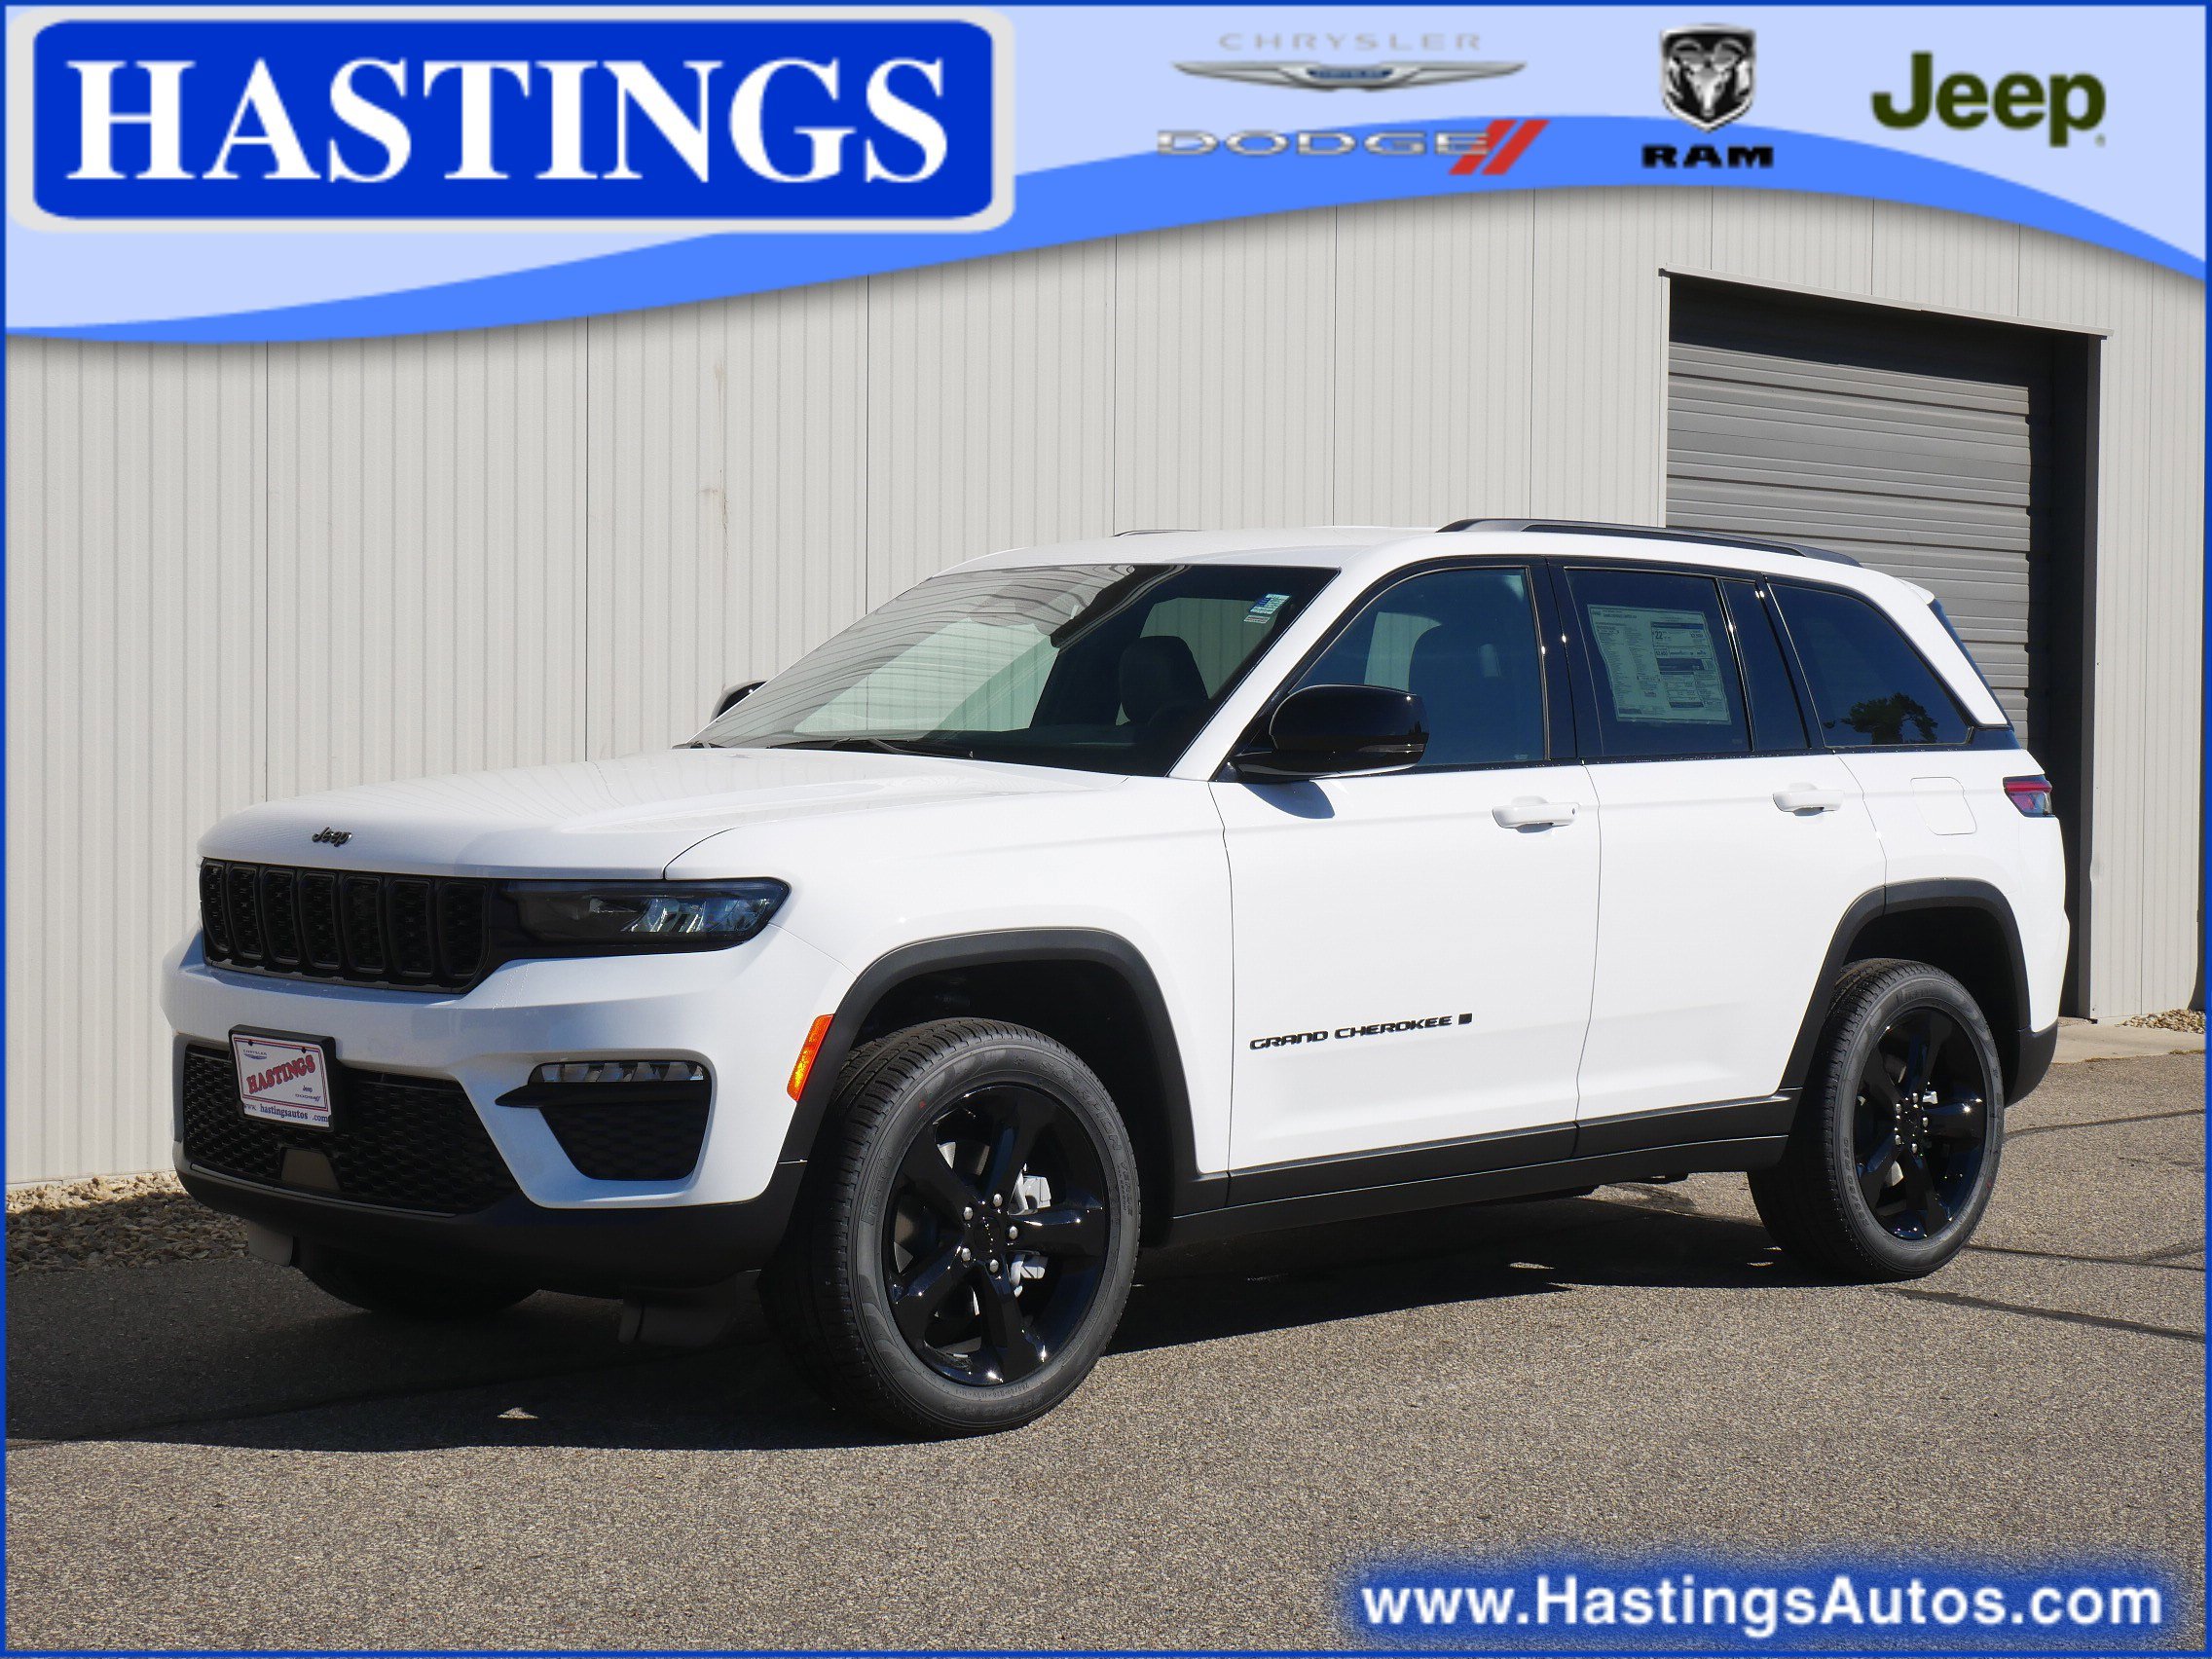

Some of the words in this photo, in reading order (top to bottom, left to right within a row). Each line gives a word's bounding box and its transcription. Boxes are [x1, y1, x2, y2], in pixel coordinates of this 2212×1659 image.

[312, 827, 351, 848] Jeep
[1249, 1030, 1329, 1051] GRAND
[1334, 1015, 1453, 1040] CHEROKEE
[246, 1054, 315, 1094] HASTINGS
[260, 1103, 309, 1119] hastingsautos
